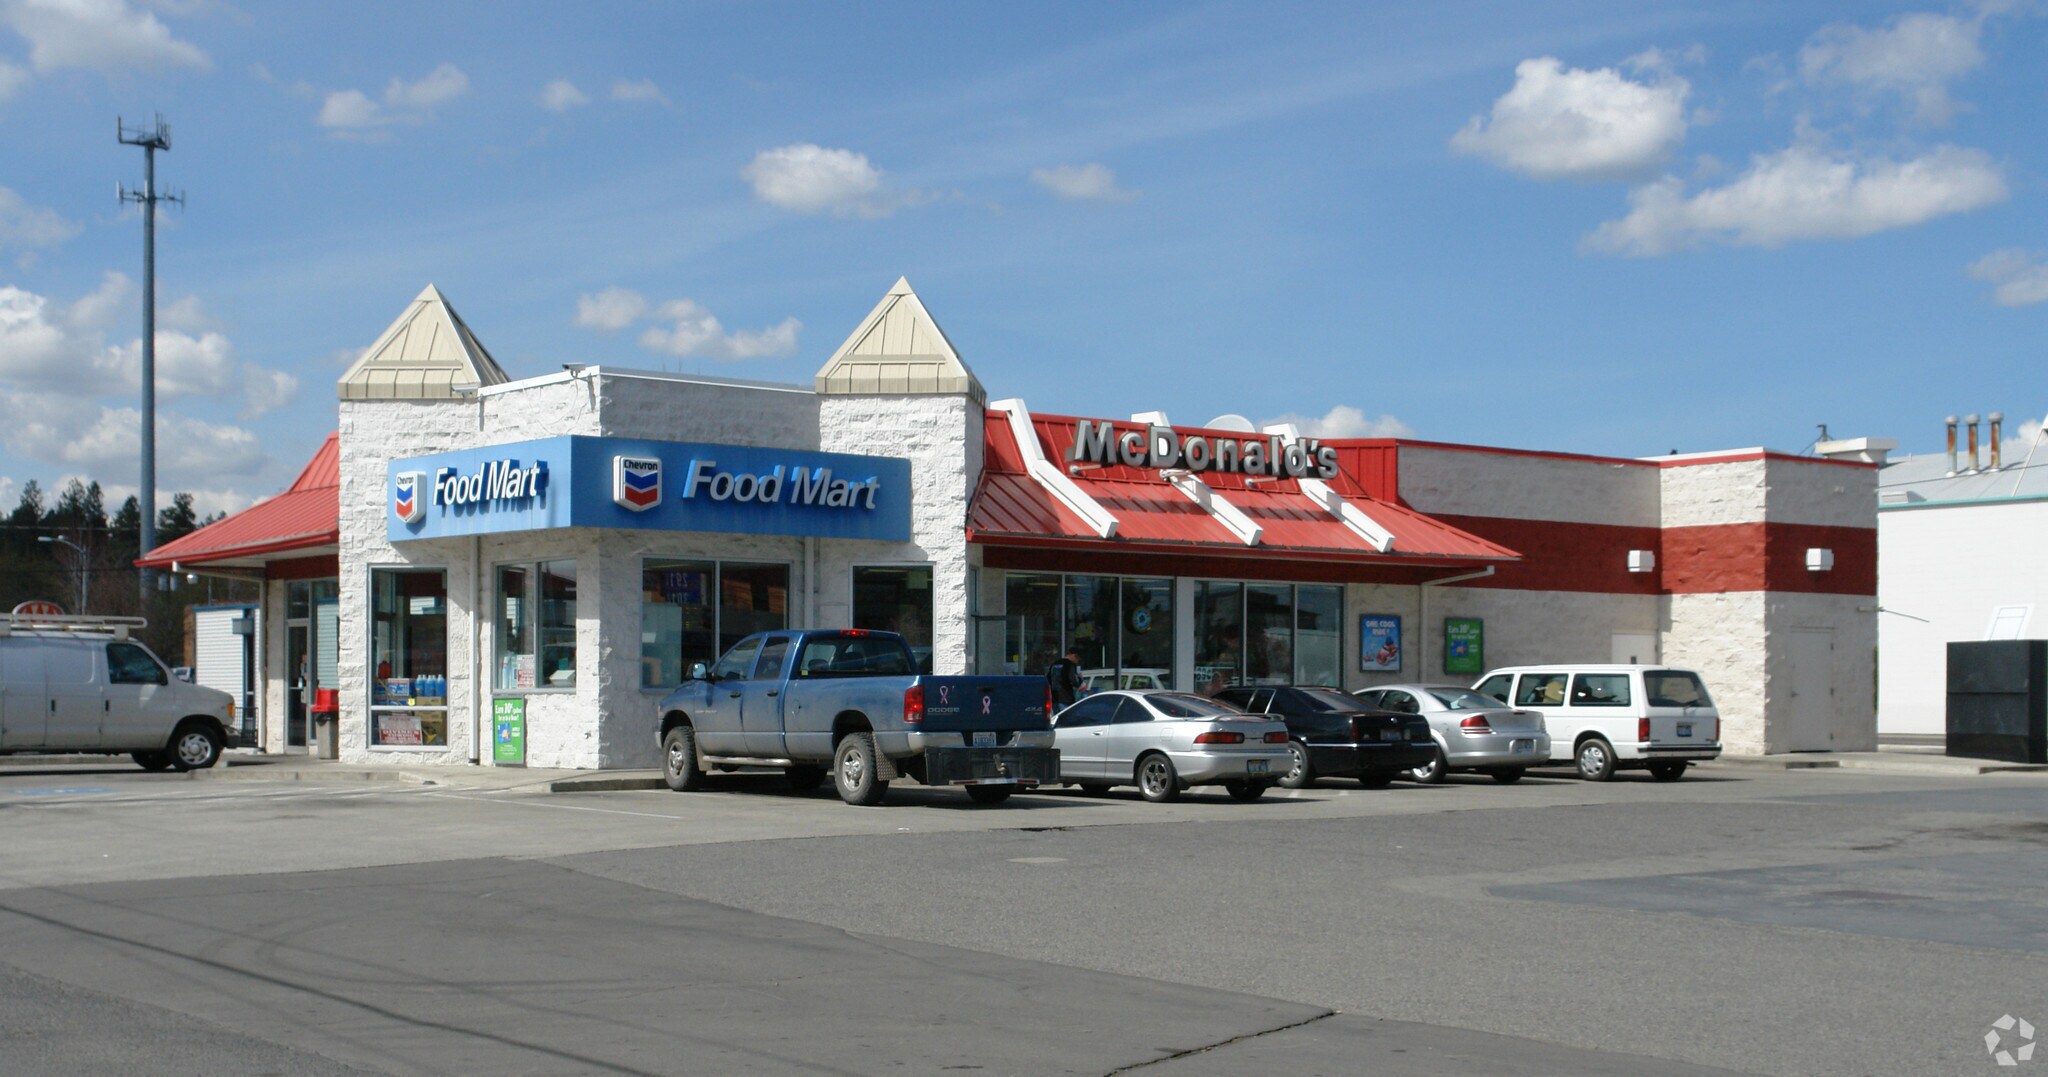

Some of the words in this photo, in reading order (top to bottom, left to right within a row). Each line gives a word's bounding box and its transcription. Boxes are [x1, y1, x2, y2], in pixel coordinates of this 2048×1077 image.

[623, 459, 658, 471] Chevron
[1069, 419, 1338, 479] McDonald's
[397, 476, 415, 485] Chevron
[433, 462, 487, 506] Food
[486, 459, 544, 501] Mart
[684, 459, 786, 504] Food
[791, 466, 880, 509] Mart
